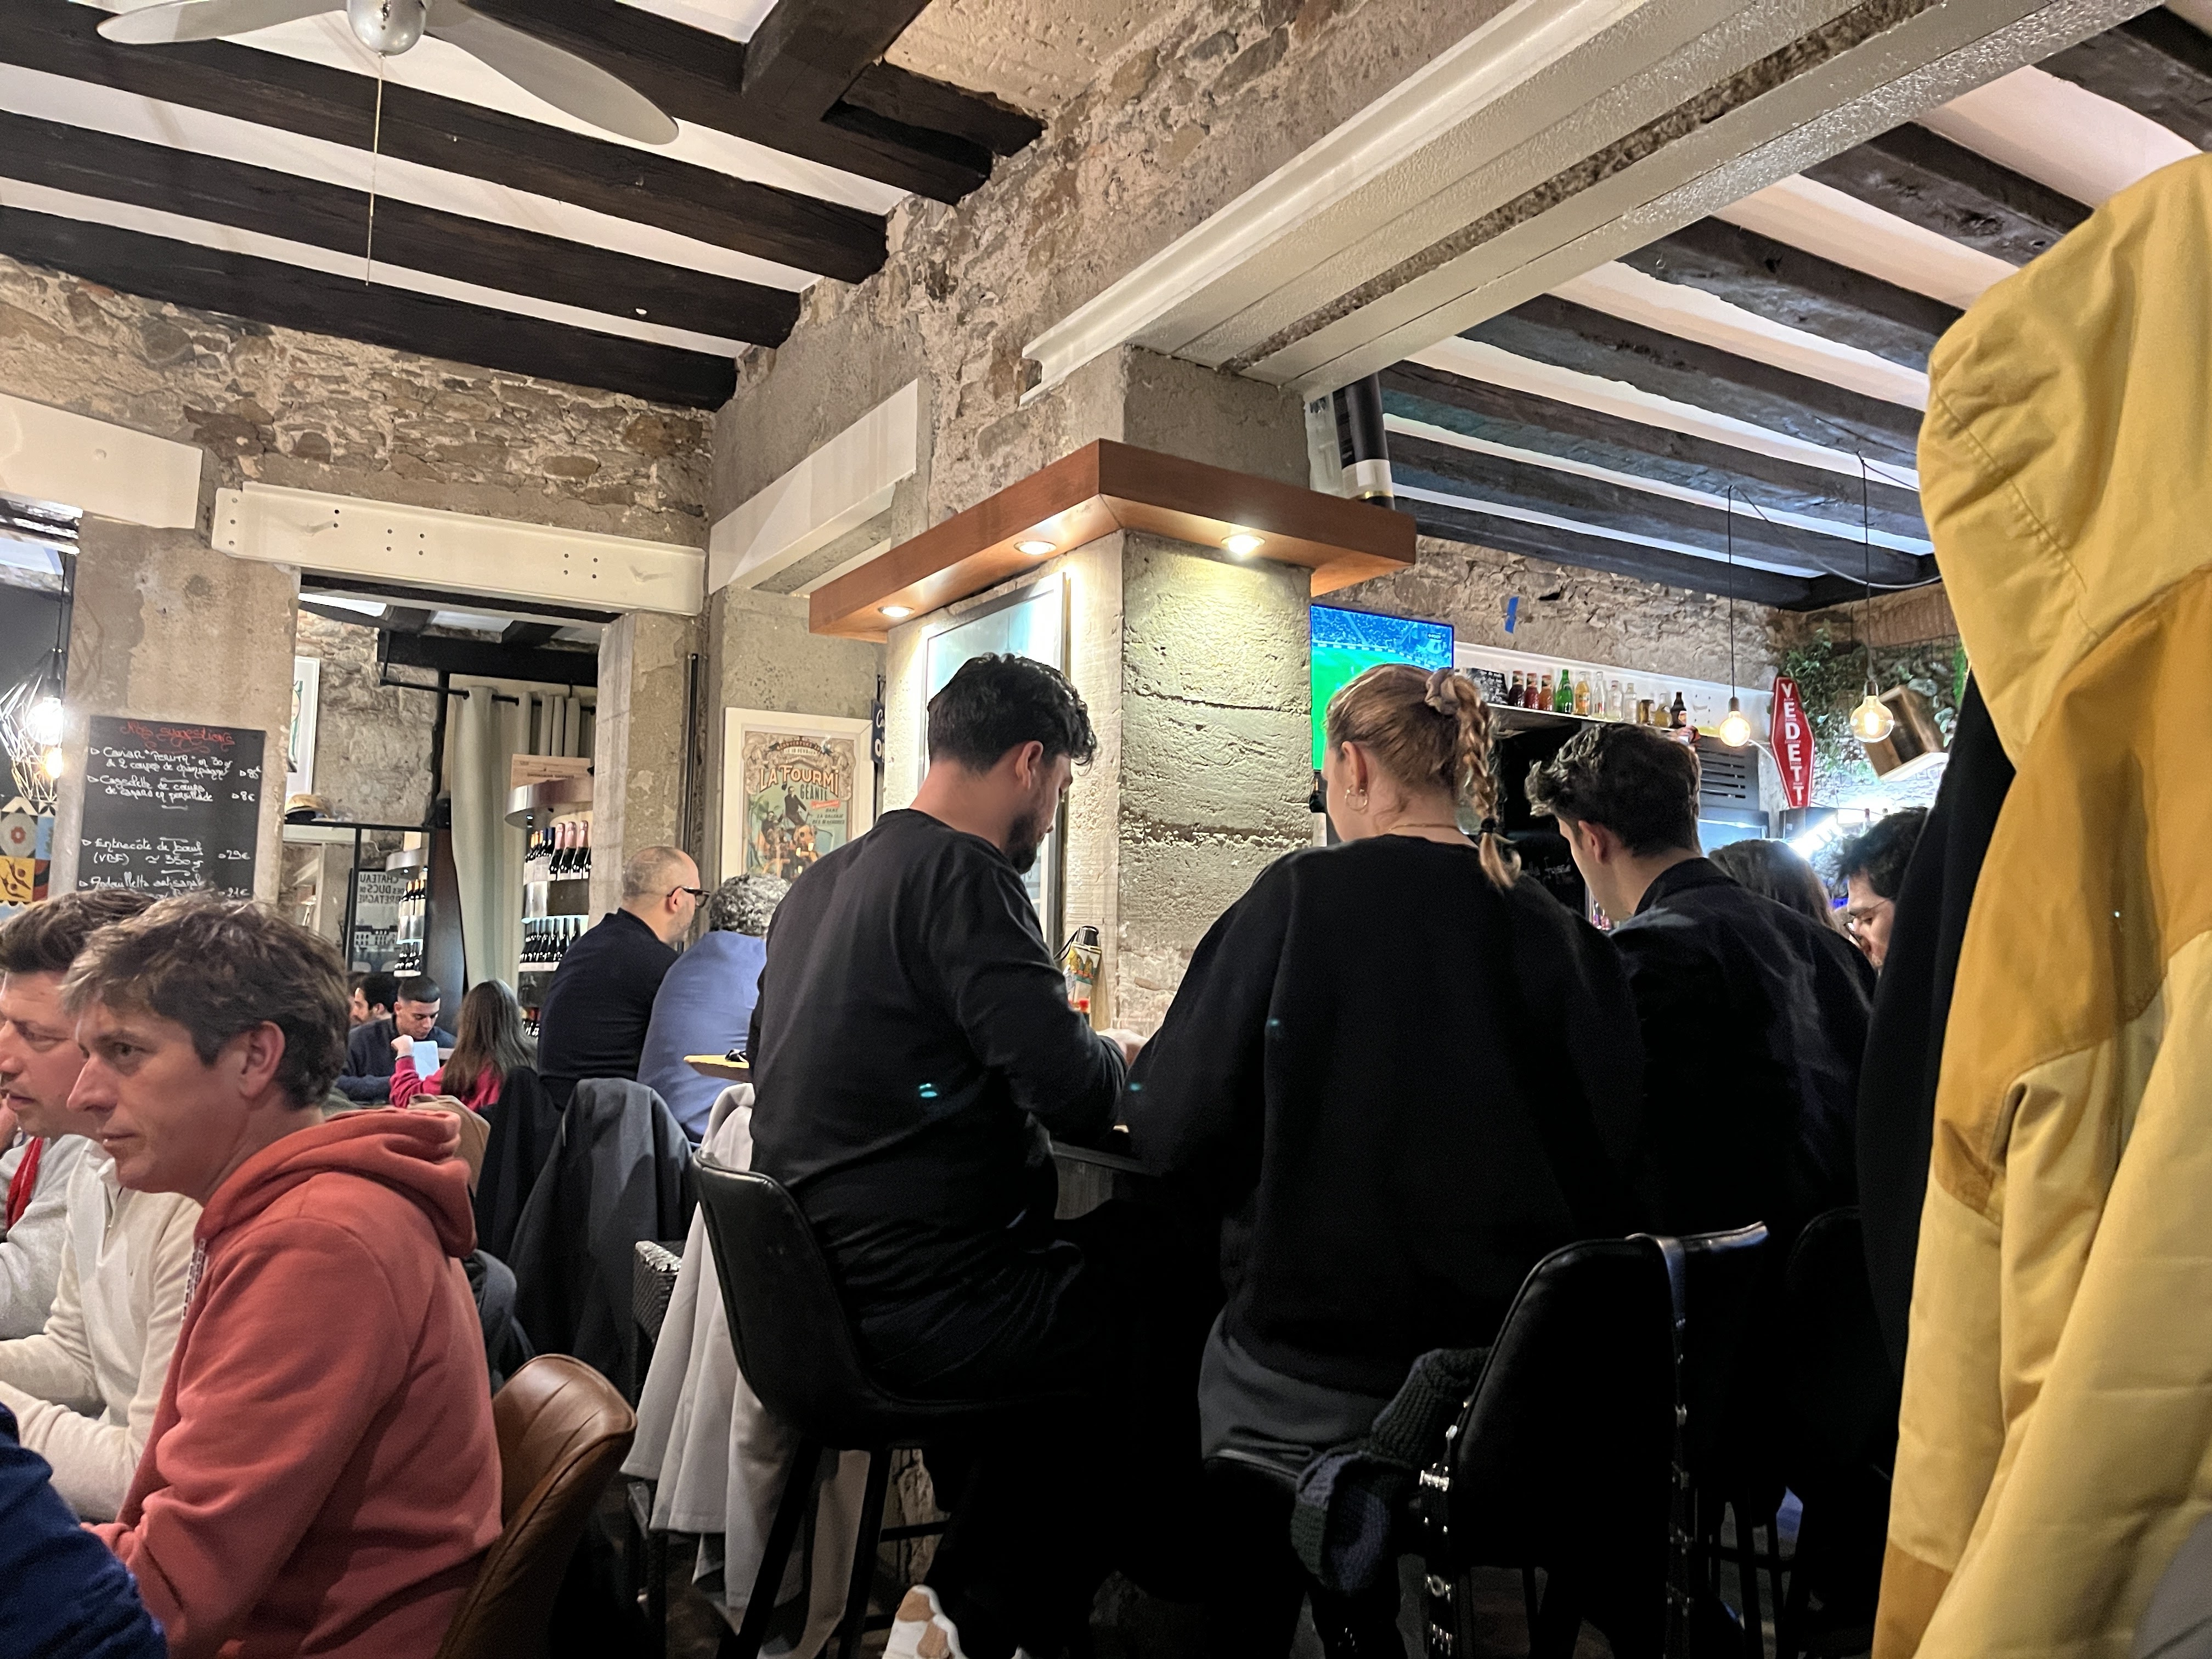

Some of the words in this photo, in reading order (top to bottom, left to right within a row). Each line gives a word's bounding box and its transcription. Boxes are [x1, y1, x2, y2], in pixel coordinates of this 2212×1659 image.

[1781, 682, 1804, 802] VEDETT
[118, 758, 128, 769] 2
[760, 768, 778, 793] LA
[778, 764, 840, 798] FOURMI
